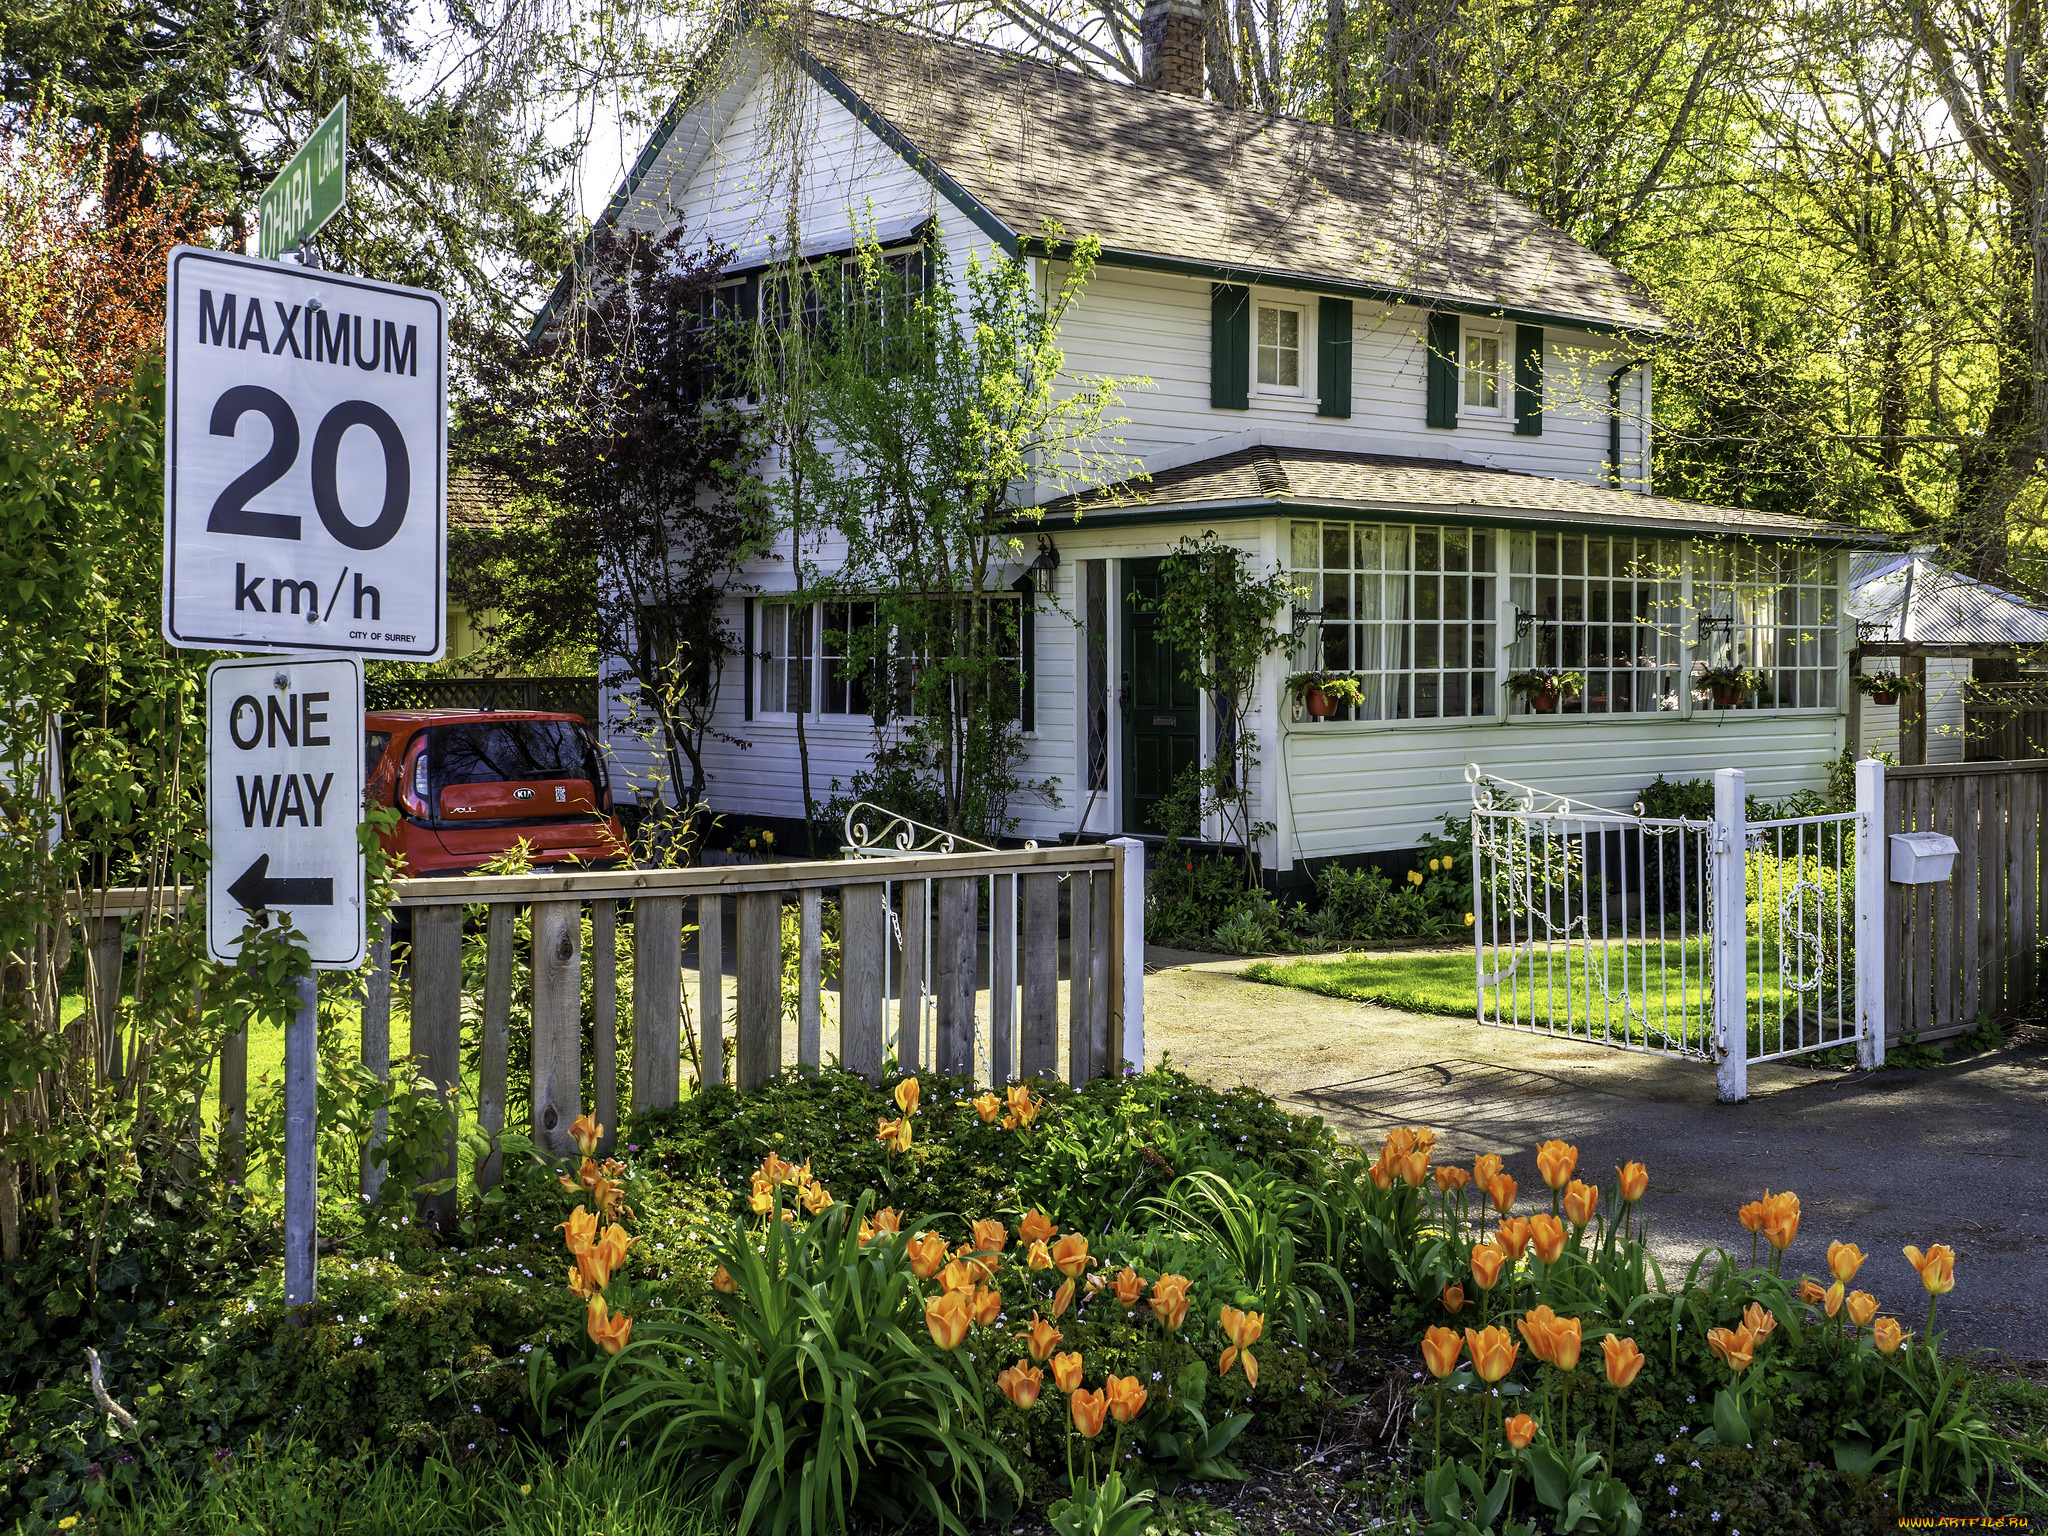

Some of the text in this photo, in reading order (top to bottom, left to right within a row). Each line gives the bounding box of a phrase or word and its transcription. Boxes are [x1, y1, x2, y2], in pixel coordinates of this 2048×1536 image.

[263, 124, 339, 260] OHARA LANE
[199, 289, 417, 377] MAXIMUM
[207, 385, 411, 550] 20
[235, 562, 381, 622] km/h
[349, 631, 416, 643] CITY OF SURREY
[229, 692, 330, 750] ONE
[236, 772, 334, 828] WAY
[516, 789, 534, 798] KIA
